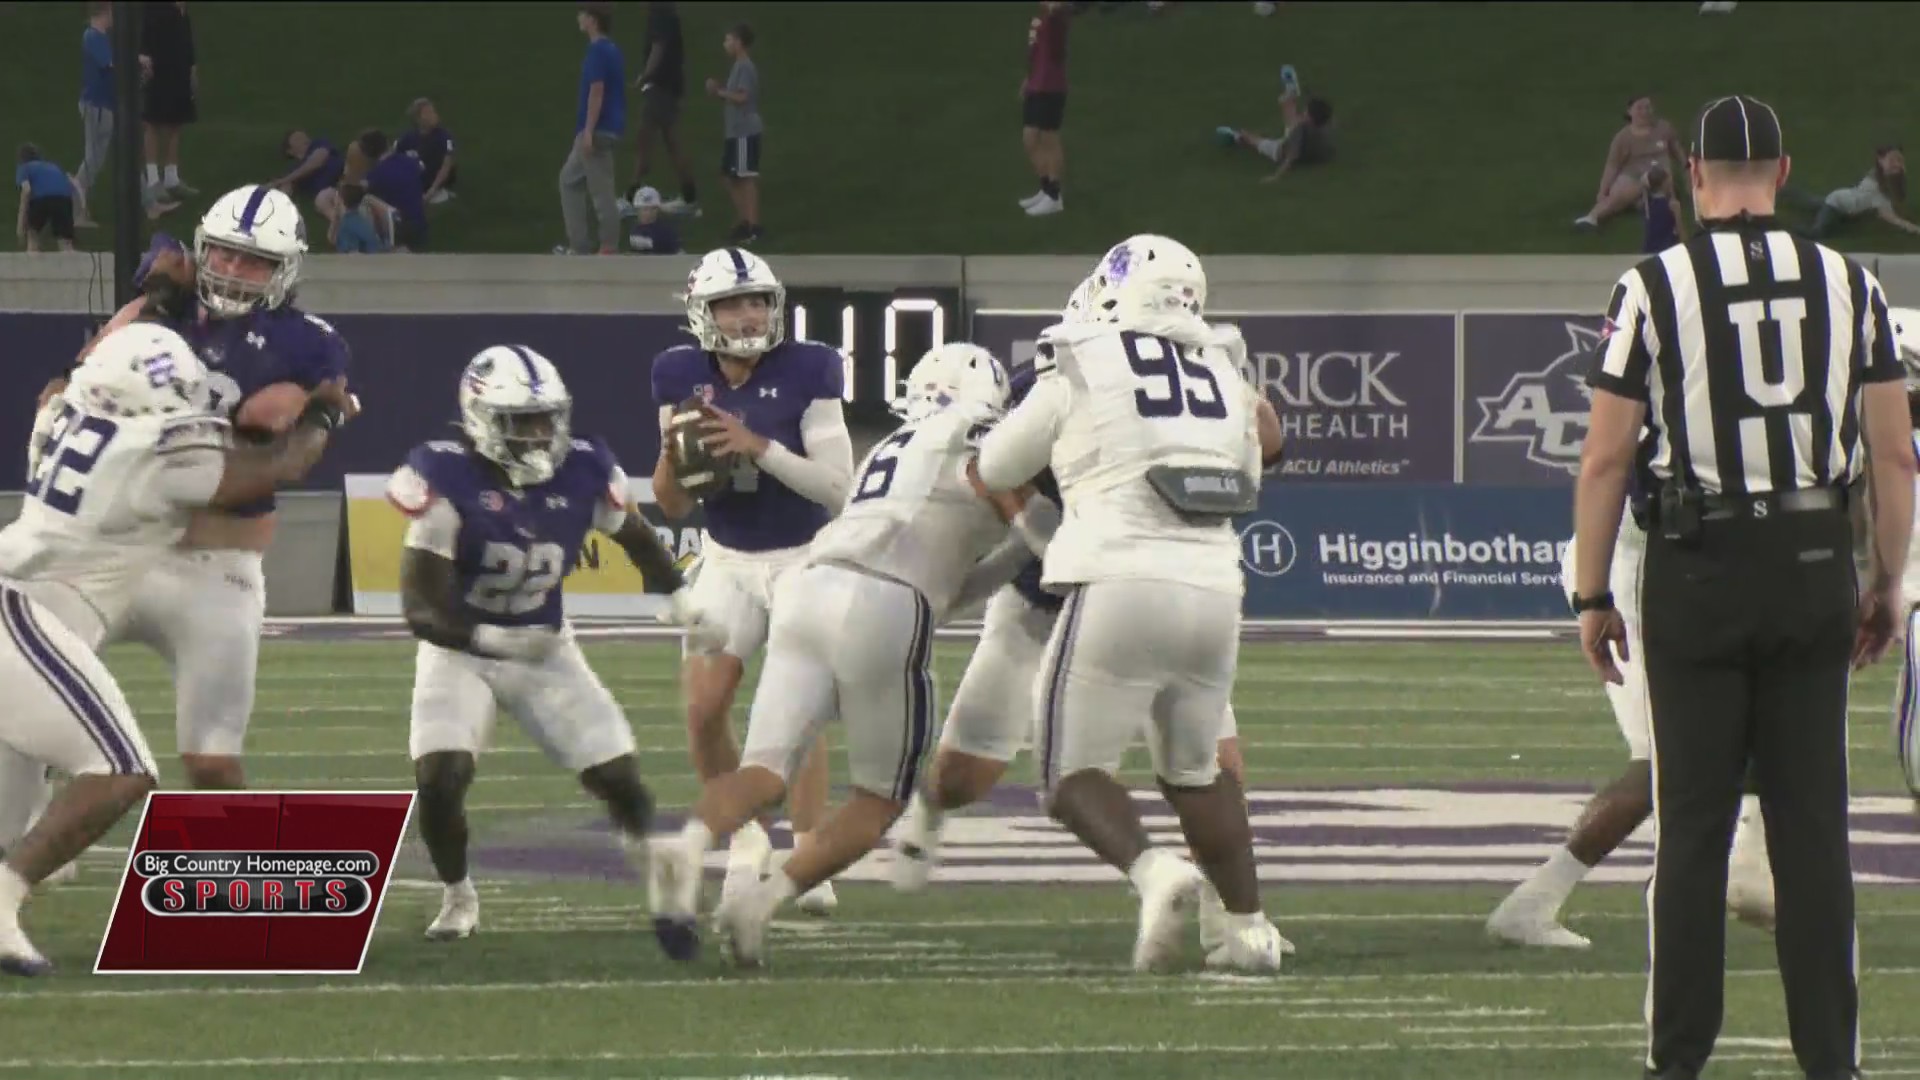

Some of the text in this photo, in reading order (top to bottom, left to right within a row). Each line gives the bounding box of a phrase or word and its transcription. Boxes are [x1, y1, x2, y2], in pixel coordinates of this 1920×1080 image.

[1120, 329, 1228, 420] 95
[1247, 351, 1407, 407] RICK
[1728, 297, 1807, 407] U
[1281, 413, 1409, 439] HEALTH
[1493, 384, 1591, 456] AC
[1281, 459, 1321, 475] ACU
[464, 541, 564, 616] 22
[1323, 571, 1404, 585] Insurance
[1408, 572, 1439, 585] and
[1443, 571, 1517, 585] Financial
